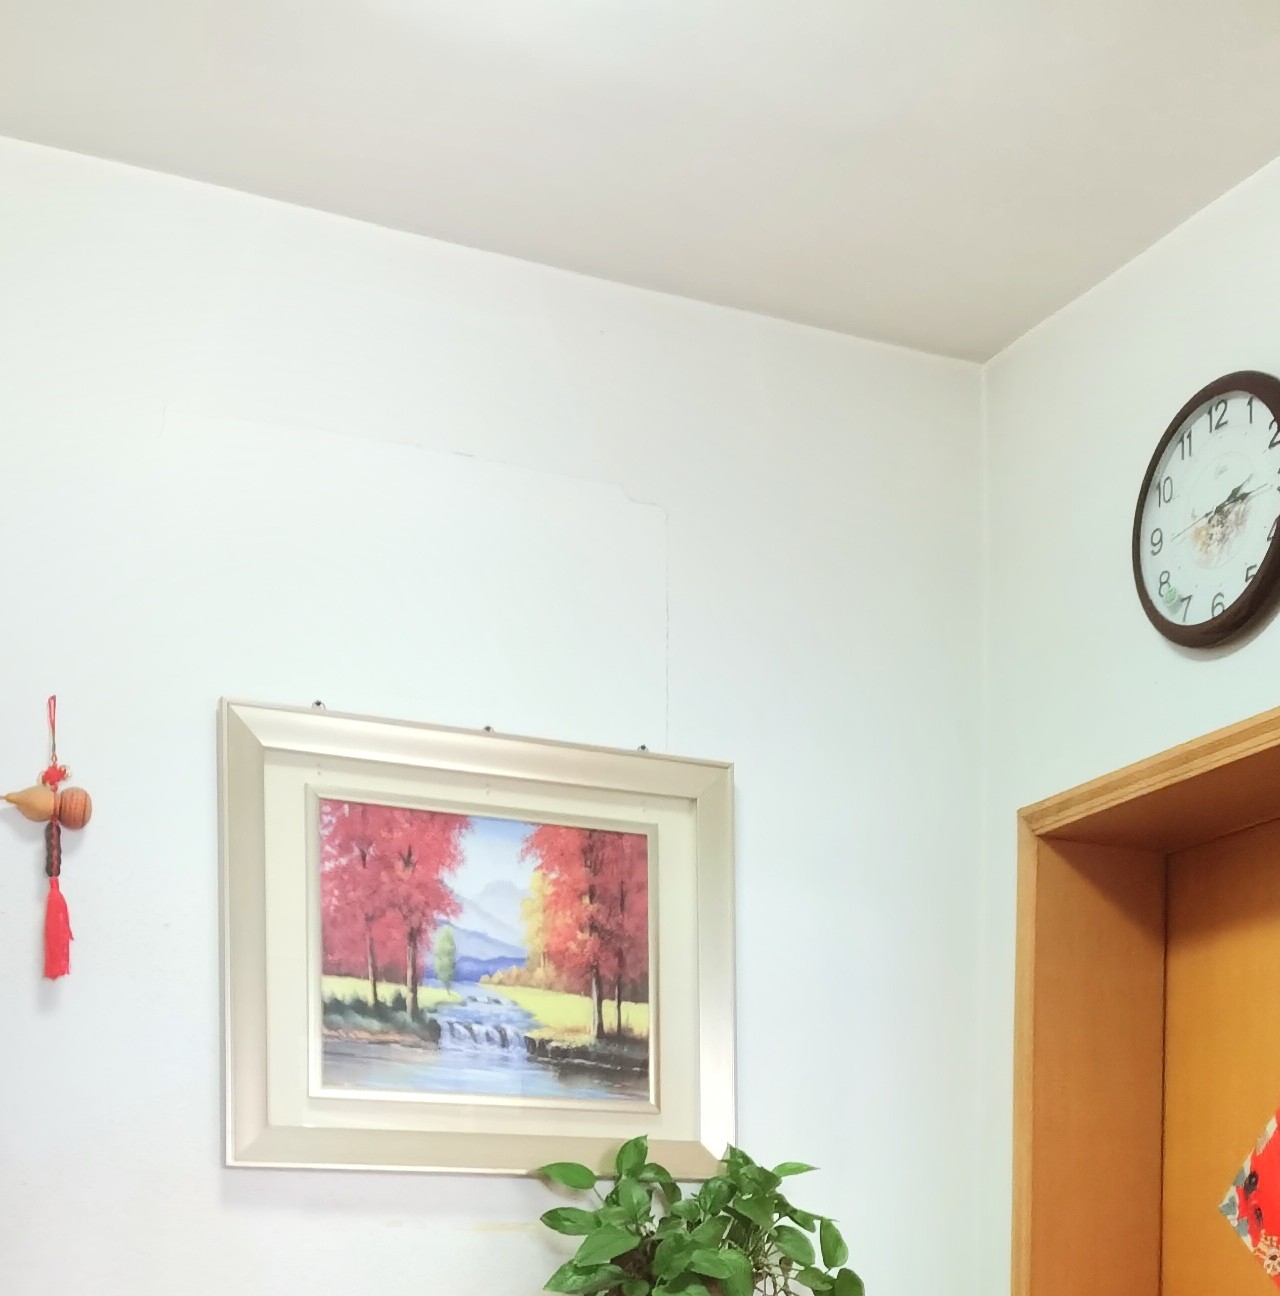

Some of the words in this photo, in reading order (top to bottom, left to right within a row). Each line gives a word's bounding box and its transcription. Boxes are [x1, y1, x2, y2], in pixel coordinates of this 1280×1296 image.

[1207, 399, 1228, 433] 12
[1246, 396, 1254, 424] 1
[1178, 429, 1193, 460] 11
[1156, 476, 1173, 508] 10
[1150, 528, 1163, 555] 9
[1158, 570, 1170, 598] 8
[1245, 564, 1258, 583] 5
[1180, 595, 1193, 622] 7
[1211, 592, 1225, 618] 6
